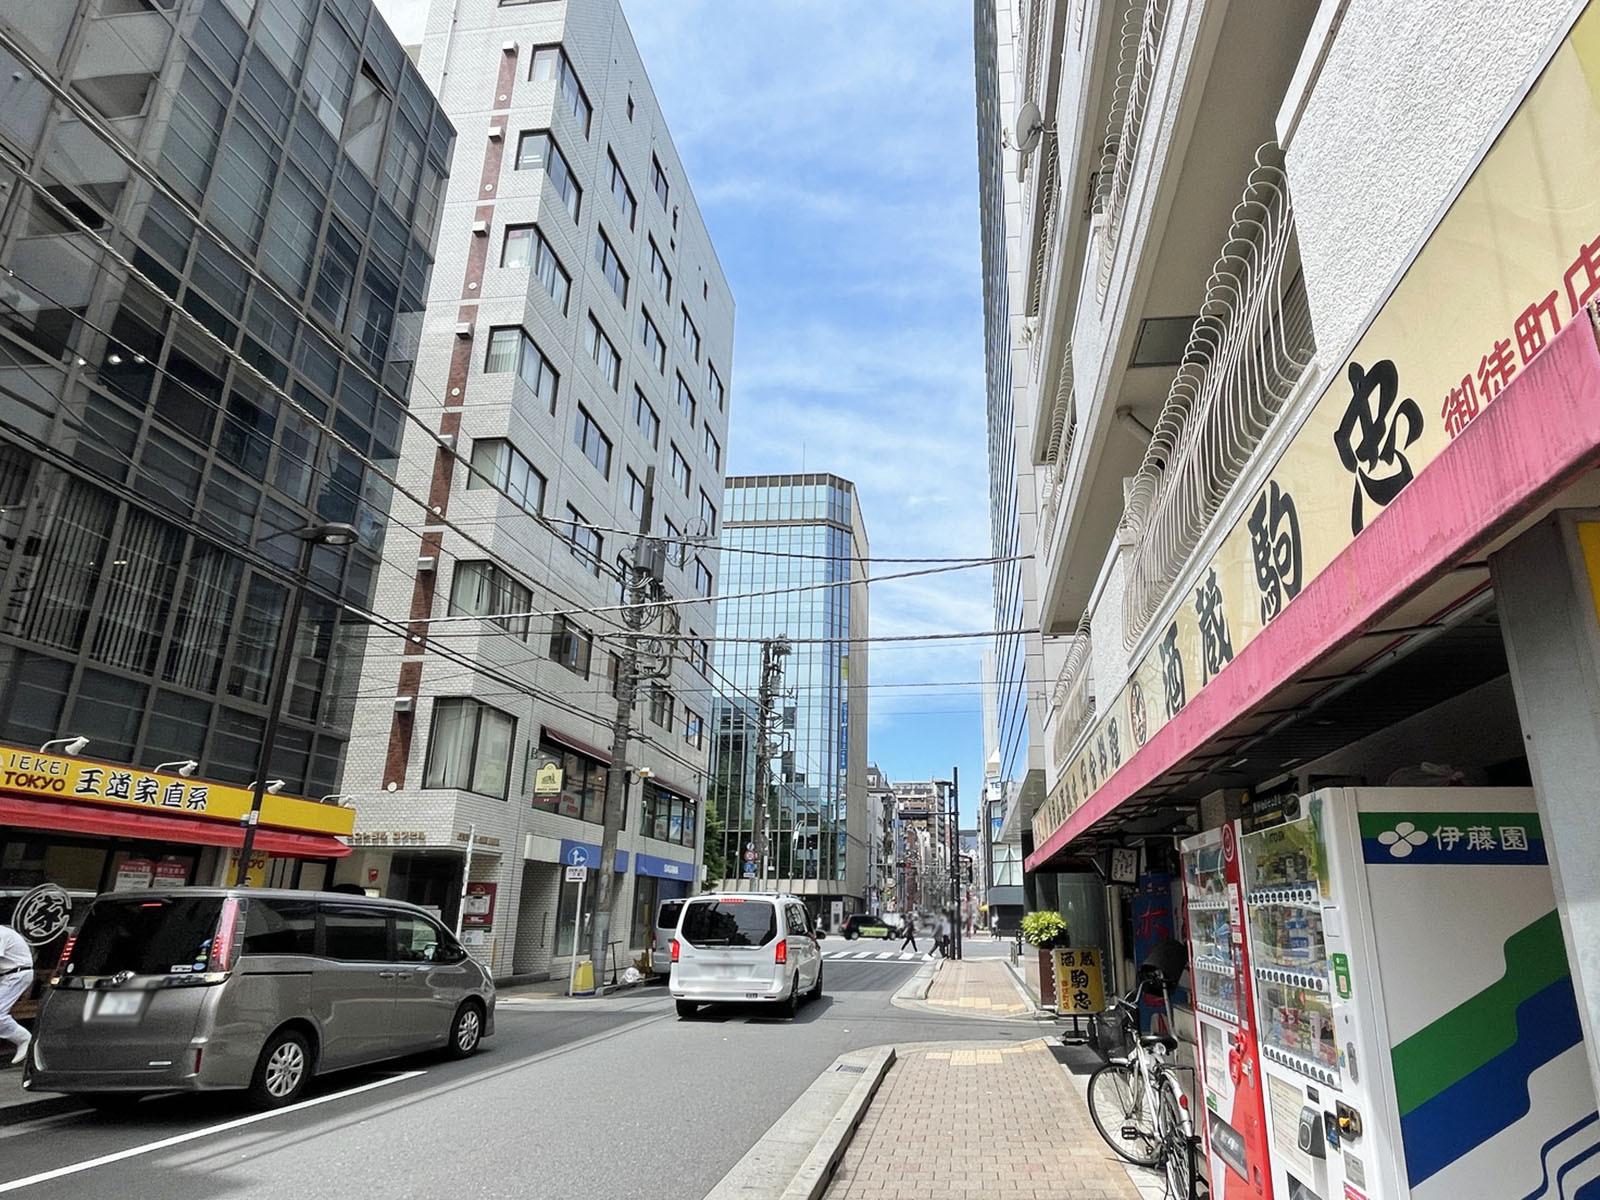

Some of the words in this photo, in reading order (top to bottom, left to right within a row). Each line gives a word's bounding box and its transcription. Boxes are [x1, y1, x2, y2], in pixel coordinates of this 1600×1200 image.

[10, 754, 70, 776] IEKEI
[4, 771, 66, 792] TOKYO
[75, 768, 209, 811] 王道家直系
[1432, 825, 1529, 851] 伊藤園
[1060, 951, 1096, 967] 酒蔵
[1070, 969, 1092, 1010] 駒忠
